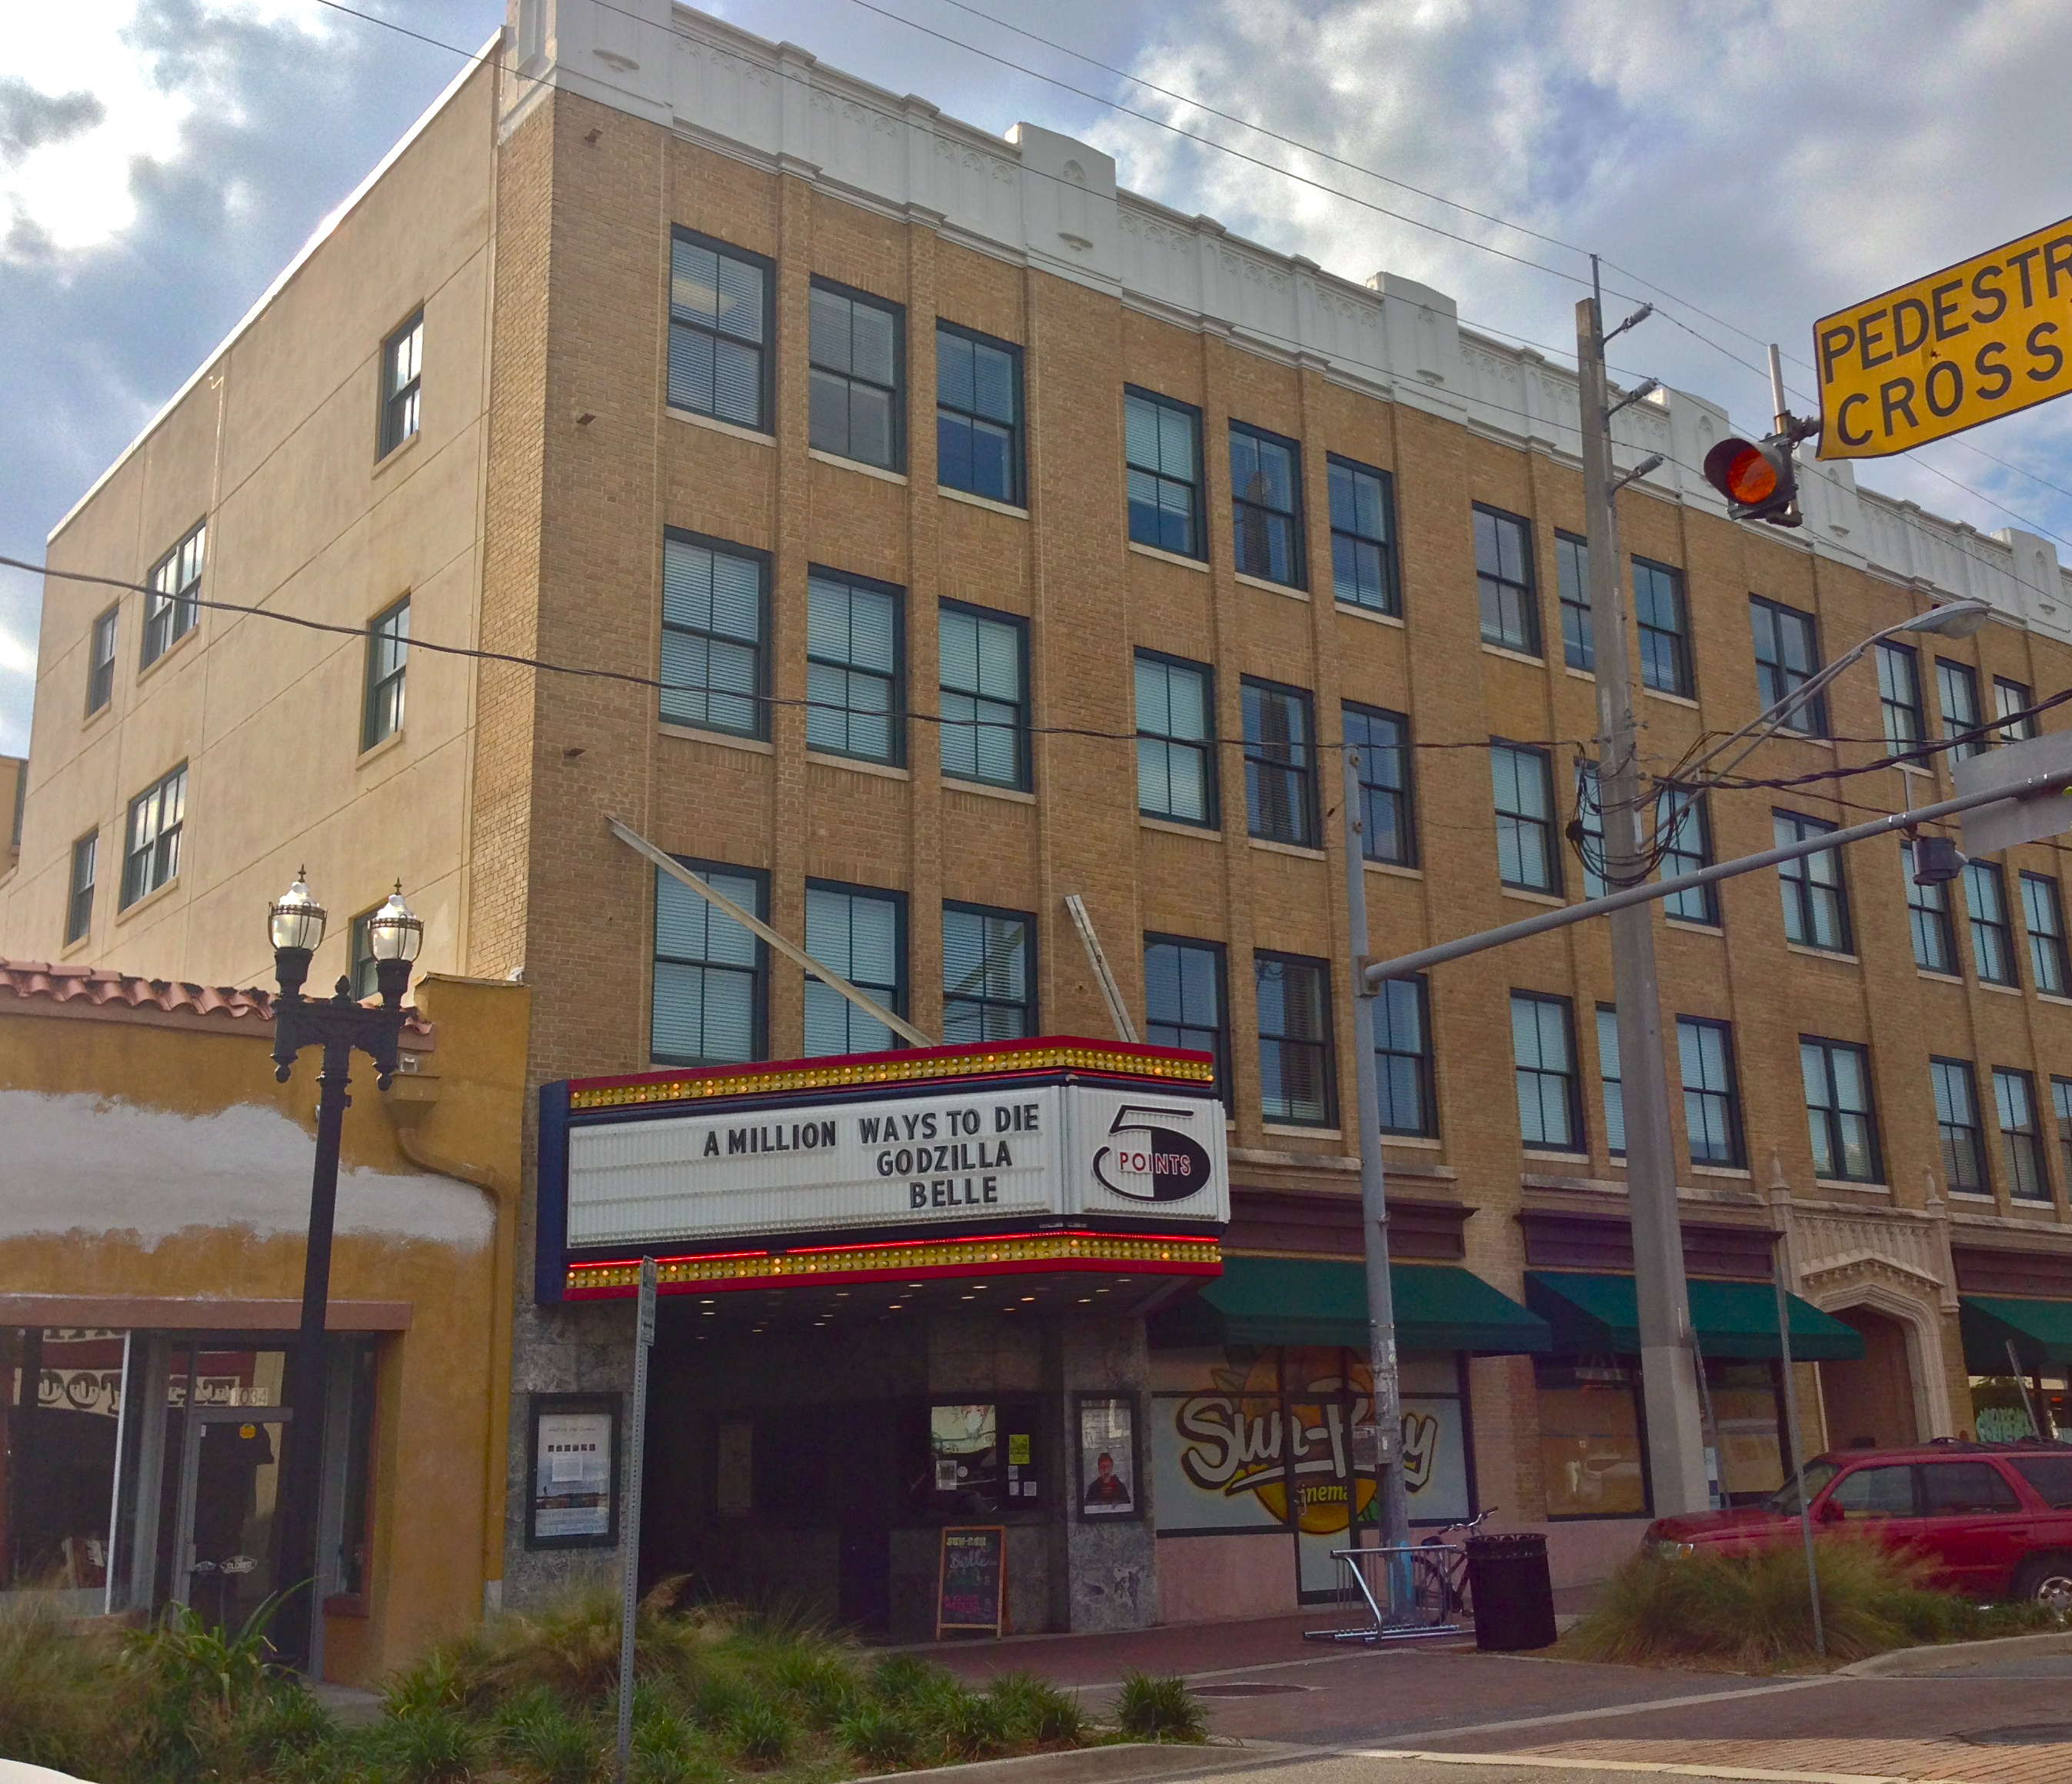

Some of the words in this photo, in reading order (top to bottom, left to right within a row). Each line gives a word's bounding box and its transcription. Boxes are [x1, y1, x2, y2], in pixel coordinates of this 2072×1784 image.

[1837, 321, 2064, 447] CROSS
[702, 1130, 720, 1157] A
[728, 1120, 836, 1155] MILLION
[858, 1112, 938, 1144] WAYS
[946, 1107, 981, 1136] TO
[994, 1103, 1038, 1133] DIE
[877, 1140, 1013, 1177] GODZILLA
[1092, 1103, 1211, 1203] 5
[1118, 1150, 1191, 1177] POINTS
[909, 1176, 998, 1209] BELLE
